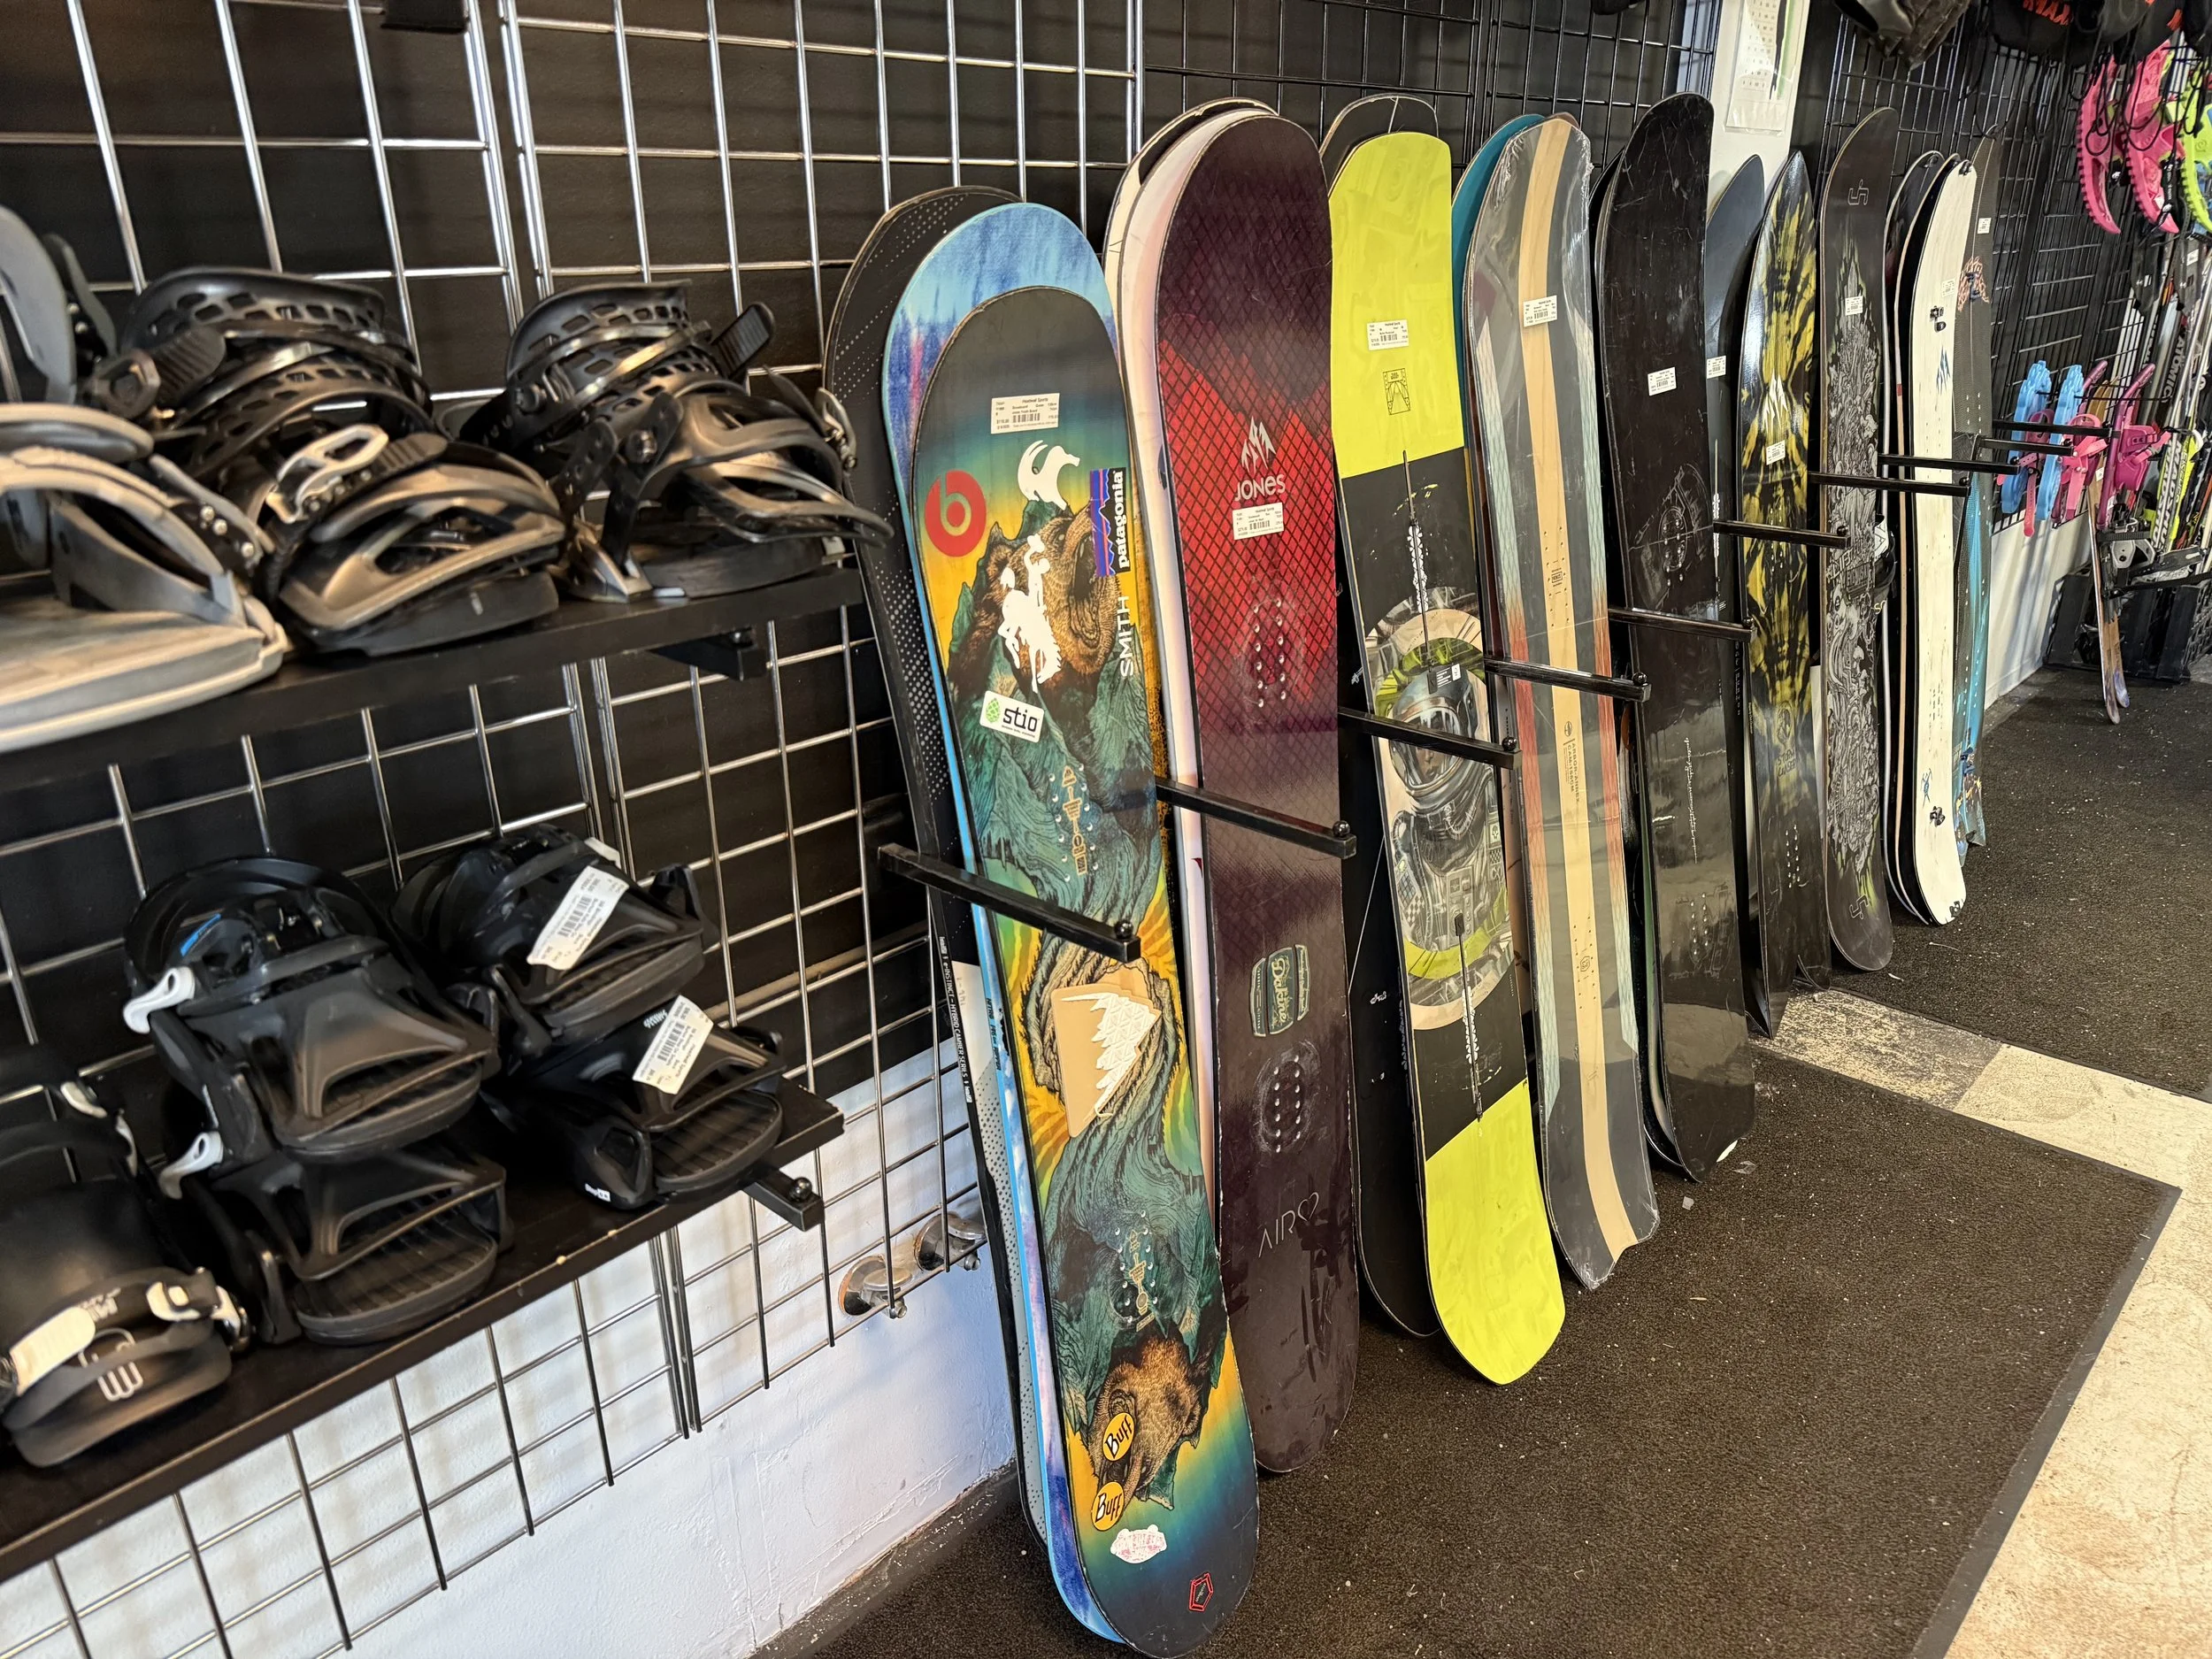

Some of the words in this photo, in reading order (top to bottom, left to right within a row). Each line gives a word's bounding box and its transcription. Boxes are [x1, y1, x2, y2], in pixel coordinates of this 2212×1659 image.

[2161, 335, 2185, 403] ATOMIC
[1234, 473, 1286, 503] JONES
[1111, 471, 1130, 569] patagonia
[1117, 595, 1134, 678] SMITH
[1002, 706, 1038, 733] stio
[1271, 956, 1290, 1025] Dakine
[949, 1003, 960, 1030] HYBRID
[954, 1028, 964, 1056] CAMBER
[958, 1054, 969, 1079] SERIES
